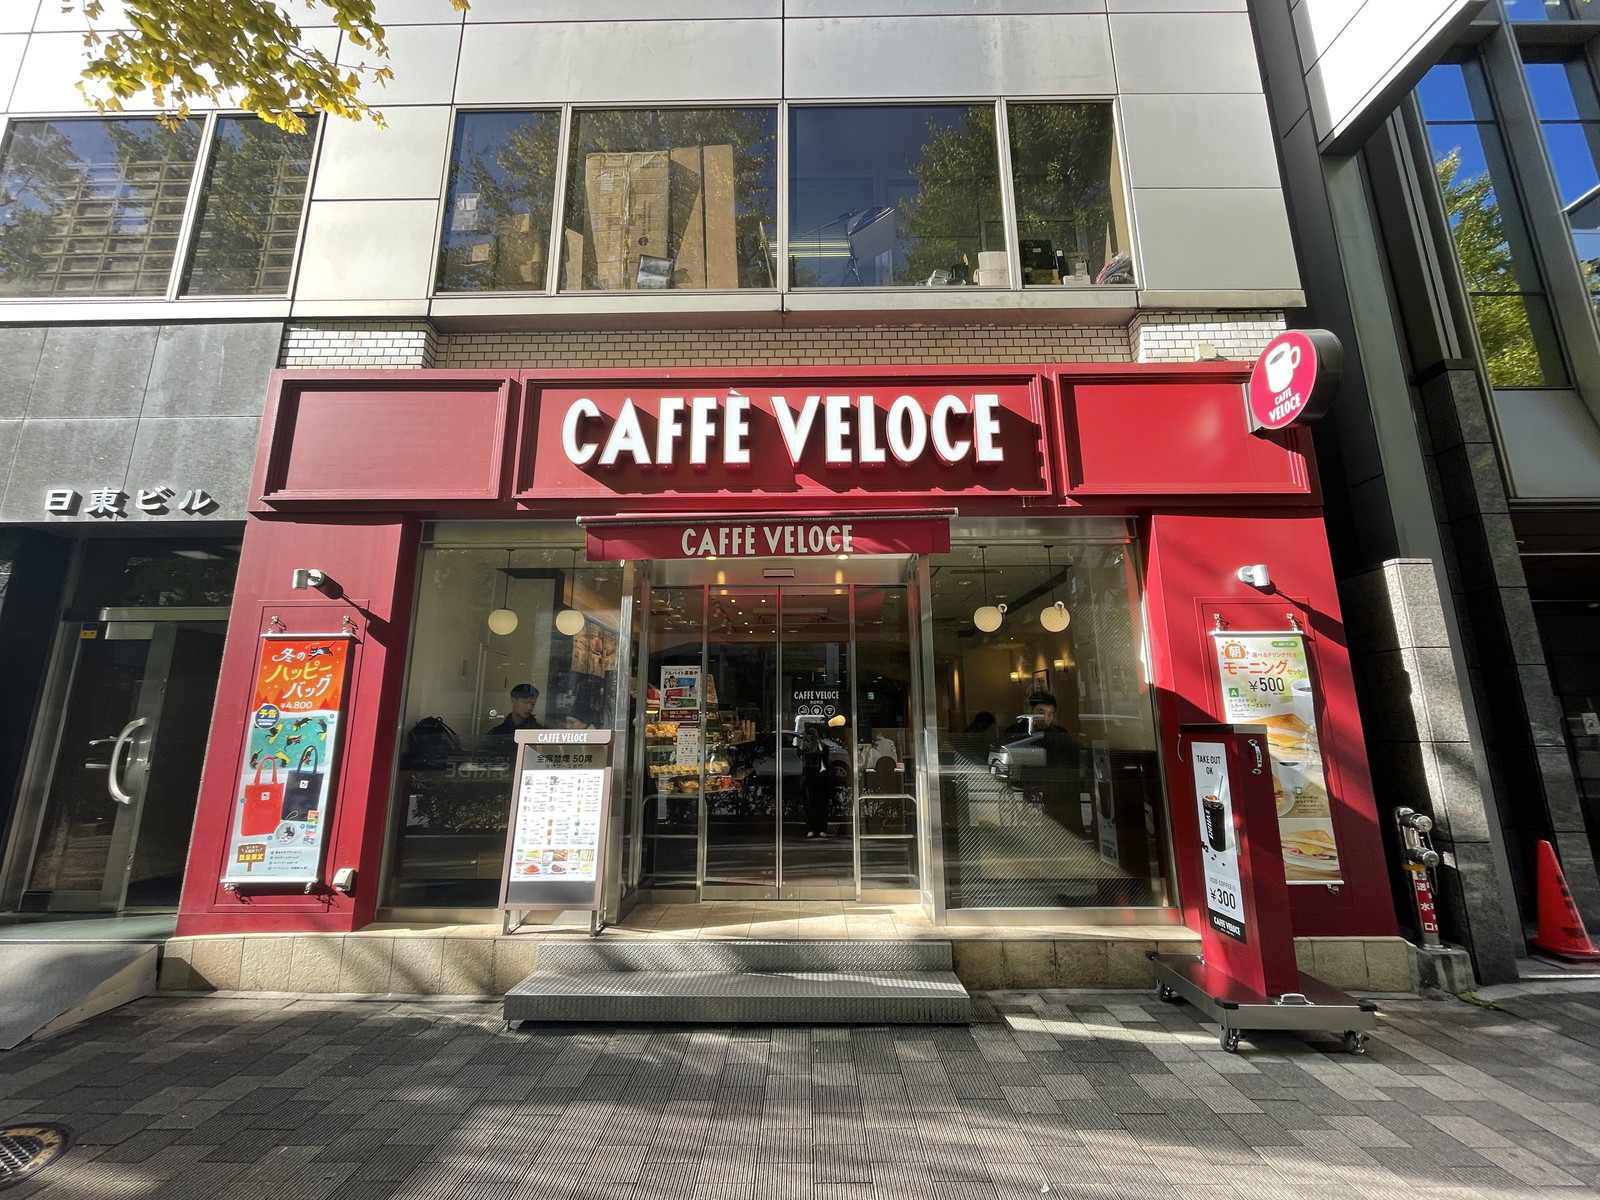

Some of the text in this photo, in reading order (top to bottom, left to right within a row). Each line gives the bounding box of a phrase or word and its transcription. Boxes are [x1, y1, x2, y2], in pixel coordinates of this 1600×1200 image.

[1268, 392, 1302, 423] VELOCE
[561, 387, 1005, 469] CAFFÈ VELOCE
[44, 485, 211, 514] 日東ビル
[763, 525, 854, 554] VELOCE
[271, 647, 306, 663] 冬の
[1228, 645, 1242, 659] 朝
[264, 660, 333, 683] ハッピー
[281, 673, 333, 699] バッグ
[1248, 677, 1285, 692] ¥500
[815, 690, 840, 700] VELOCE
[561, 732, 588, 742] VELOCE
[536, 754, 571, 763] 全席禁煙
[1196, 754, 1221, 765] TAKE OUT
[1205, 766, 1214, 775] OK
[1209, 887, 1236, 910] ¥300
